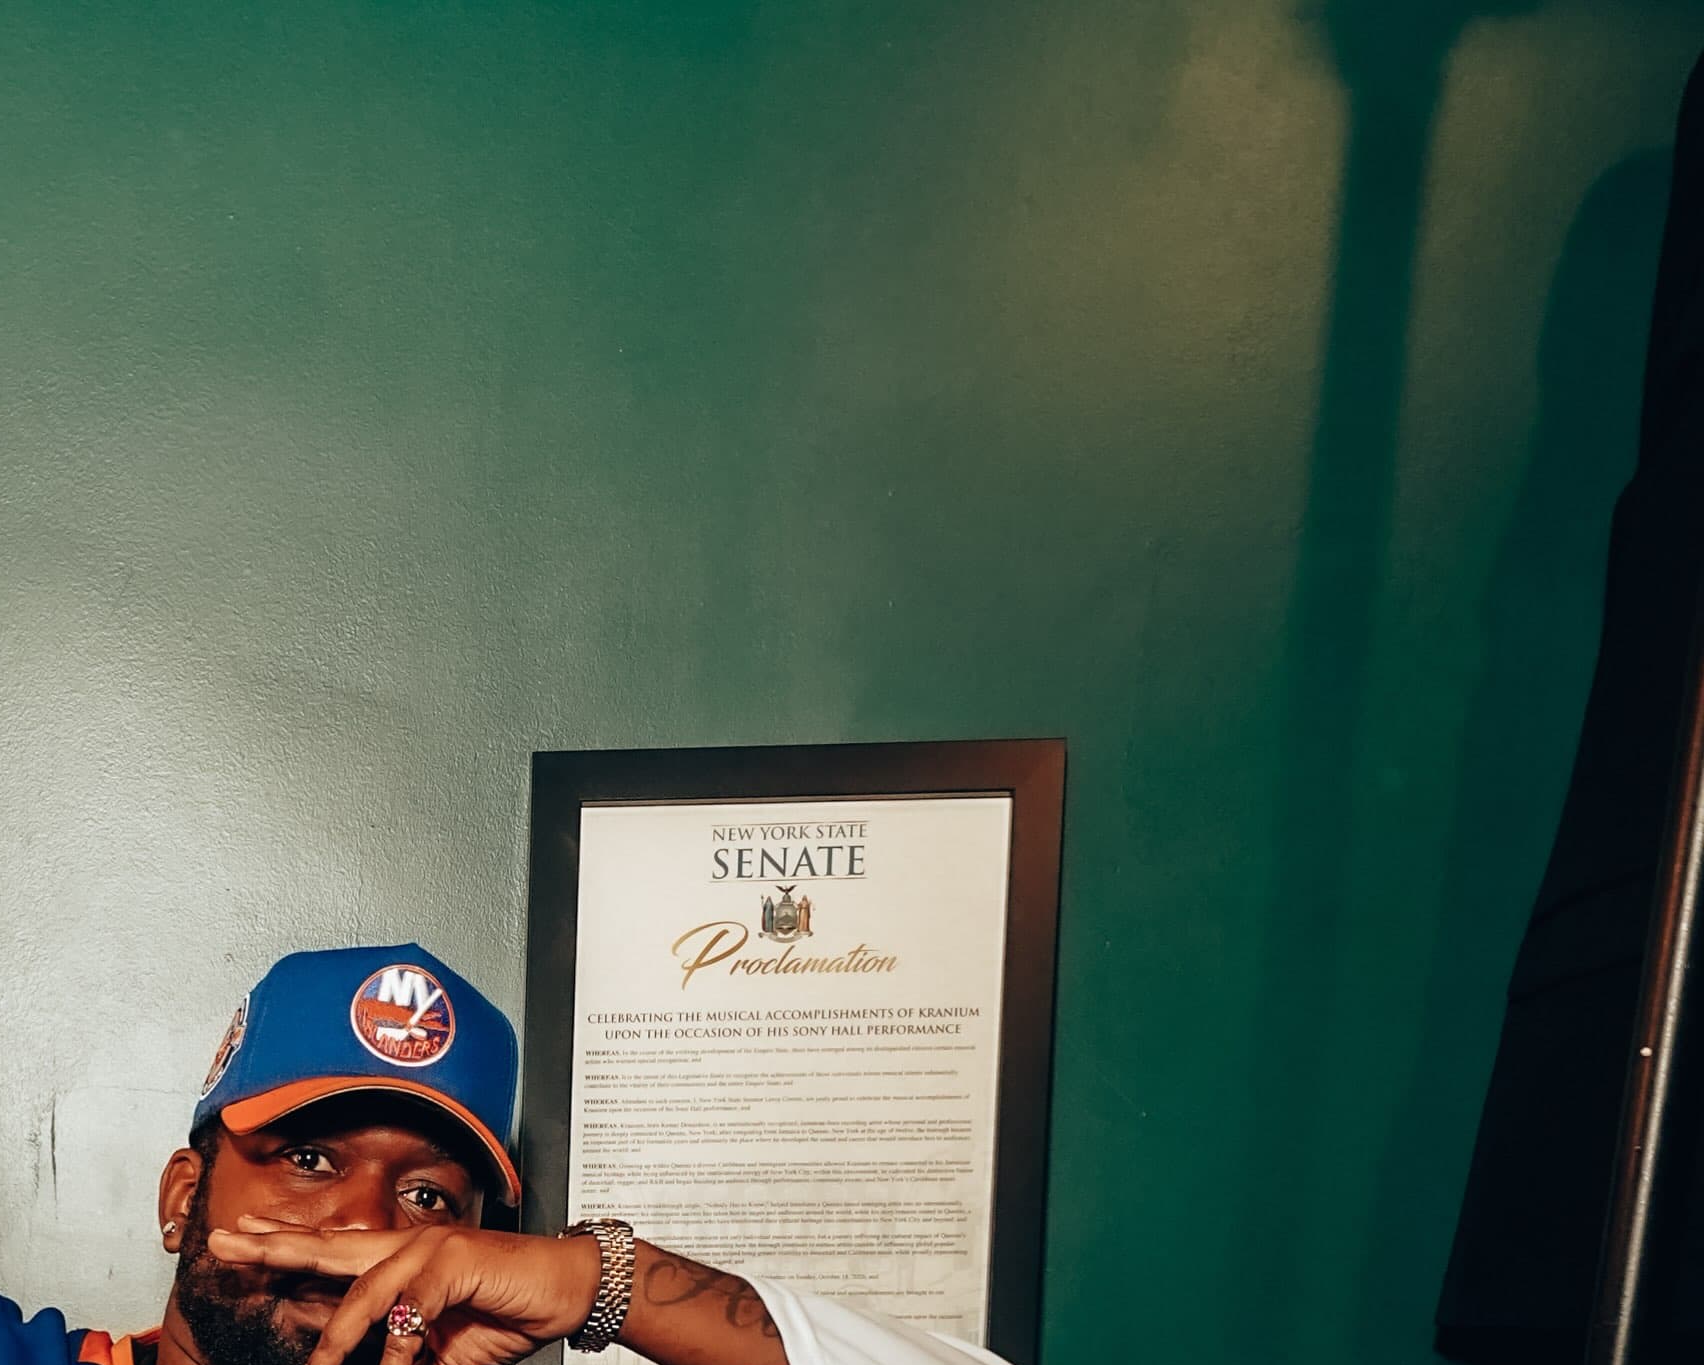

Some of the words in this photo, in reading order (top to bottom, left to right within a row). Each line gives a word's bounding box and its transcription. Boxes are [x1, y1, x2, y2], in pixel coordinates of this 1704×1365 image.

[712, 826, 756, 842] NEW
[760, 825, 812, 841] YORK
[815, 823, 868, 839] STATE
[711, 845, 867, 881] SENATE
[671, 920, 902, 992] Proclamation
[587, 1012, 673, 1024] CELEBRATING
[677, 1012, 702, 1023] THE
[705, 1010, 762, 1022] MUSICAL
[765, 1008, 894, 1021] ACCOMPLISHMENTS
[897, 1007, 915, 1018] OF
[918, 1007, 981, 1018] KRANIUM
[605, 1030, 641, 1040] UPON
[646, 1029, 671, 1039] THE
[674, 1027, 742, 1039] OCCASION
[745, 1027, 764, 1037] OF
[767, 1026, 789, 1037] HIS
[792, 1026, 828, 1037] SONY
[831, 1025, 863, 1036] HALL
[866, 1024, 962, 1035] PERFORMANCE
